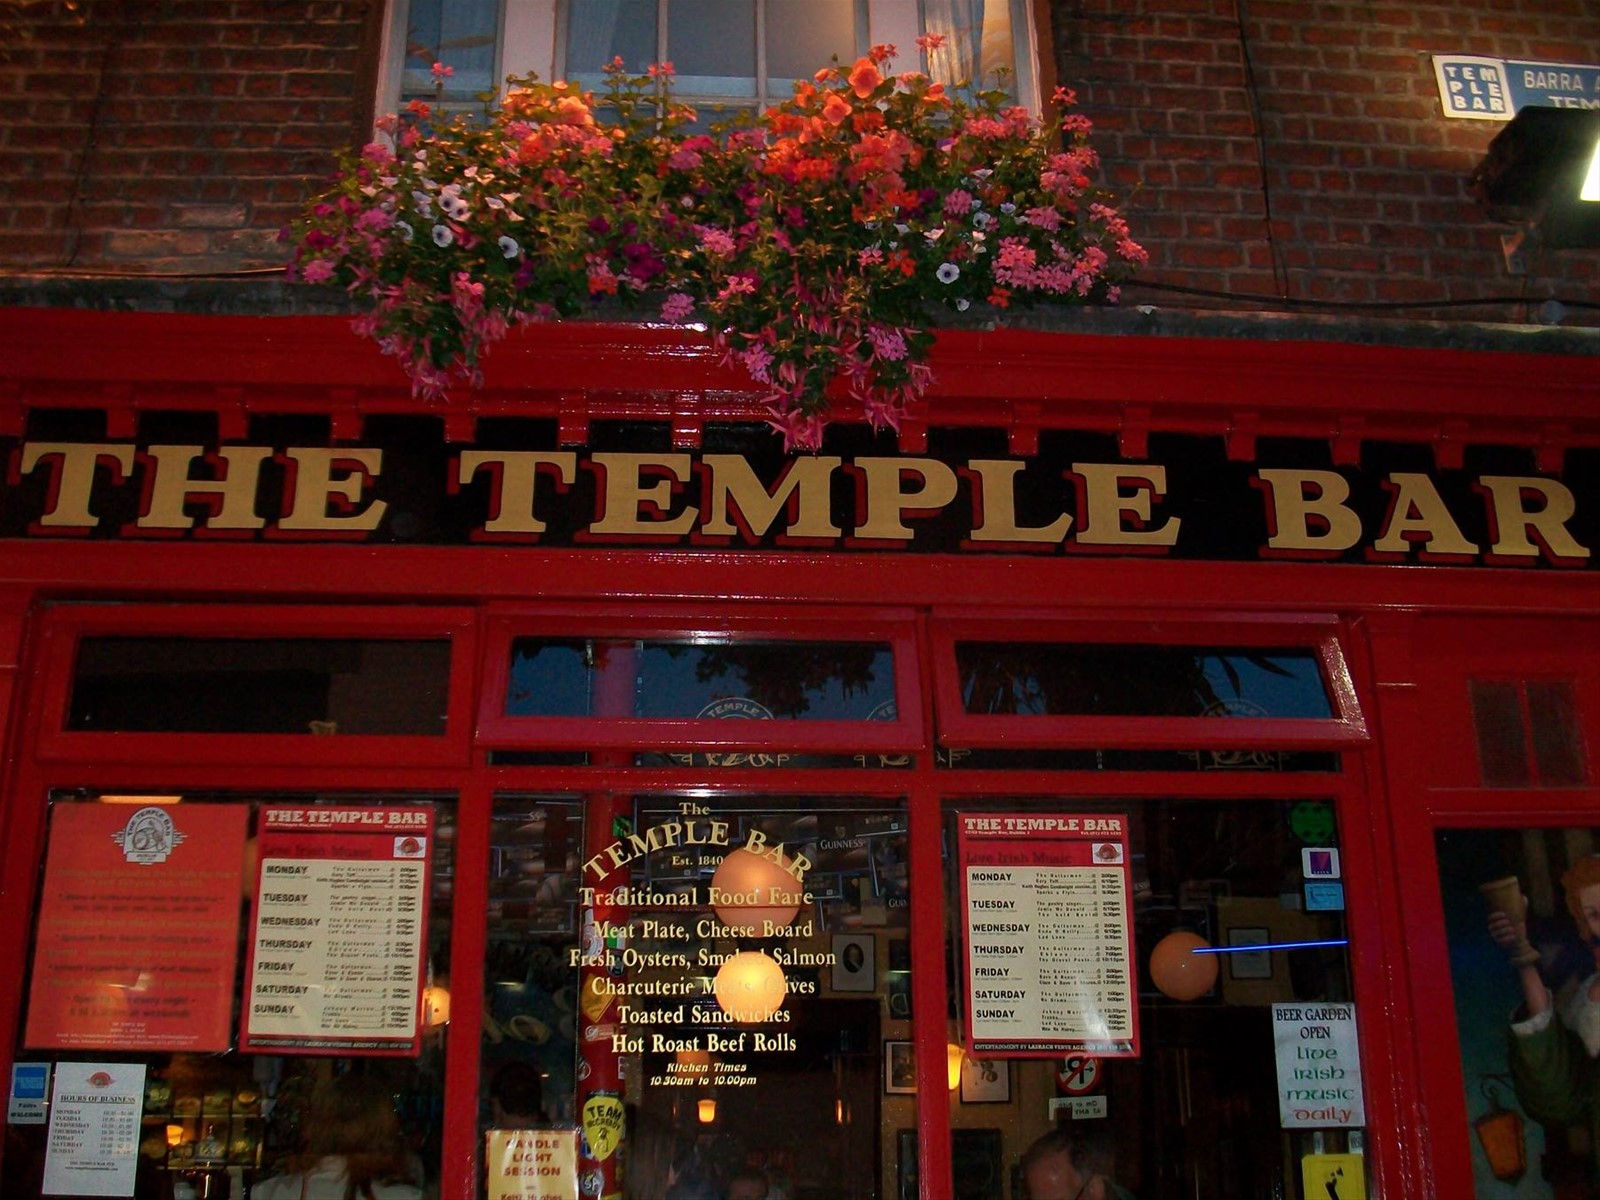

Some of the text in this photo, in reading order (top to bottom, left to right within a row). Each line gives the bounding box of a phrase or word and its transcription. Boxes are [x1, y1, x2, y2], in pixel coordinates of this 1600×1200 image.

[1445, 66, 1498, 82] TEM
[1524, 70, 1584, 92] BARRA
[1450, 81, 1502, 97] PLE
[1453, 95, 1505, 111] BAR
[21, 442, 1592, 558] THE TEMPLE BAR
[707, 702, 759, 717] TEMPLE
[679, 802, 710, 816] The
[266, 810, 428, 825] THE TEMPLE BAR
[964, 818, 1122, 831] THE TEMPLE BAR
[820, 839, 863, 850] GUINNESS
[582, 820, 812, 882] TEMPLE BAR
[966, 851, 993, 862] Live
[1033, 851, 1072, 863] Music
[672, 855, 724, 866] Est. 1840
[266, 866, 308, 874] MONDAY
[971, 873, 1012, 881] MONDAY
[263, 893, 308, 903] TUESDAY
[579, 886, 814, 906] Traditional Food Fare
[971, 900, 1015, 909] TUESDAY
[260, 917, 320, 927] WEDNESDAY
[972, 923, 1030, 932] WEDNESDAY
[594, 919, 813, 942] Meat Plate, Cheese Board
[259, 939, 313, 949] THURSDAY
[973, 945, 1025, 954] THURSDAY
[257, 961, 294, 971] FRIDAY
[569, 947, 837, 973] Fresh Oysters, Smod Salmon
[975, 967, 1010, 977] FRIDAY
[255, 984, 309, 994] SATURDAY
[591, 976, 696, 995] Charcuterie
[764, 975, 815, 994] Oives
[975, 990, 1026, 999] SATURDAY
[254, 1004, 295, 1014] SUNDAY
[617, 1005, 790, 1024] Toasted Sandwiches
[976, 1010, 1015, 1019] SUNDAY
[1276, 1007, 1352, 1022] BEER GARDEN
[1300, 1027, 1331, 1039] OPEN
[611, 1032, 797, 1053] Hot Roast Beef Rolls
[666, 1062, 747, 1073] Kitchen Times
[650, 1075, 757, 1088] 10.30am to 10.00pm
[60, 1095, 87, 1103] HOURS
[88, 1095, 97, 1103] OF
[586, 1105, 622, 1119] TEAM
[512, 1153, 553, 1163] LIGHT
